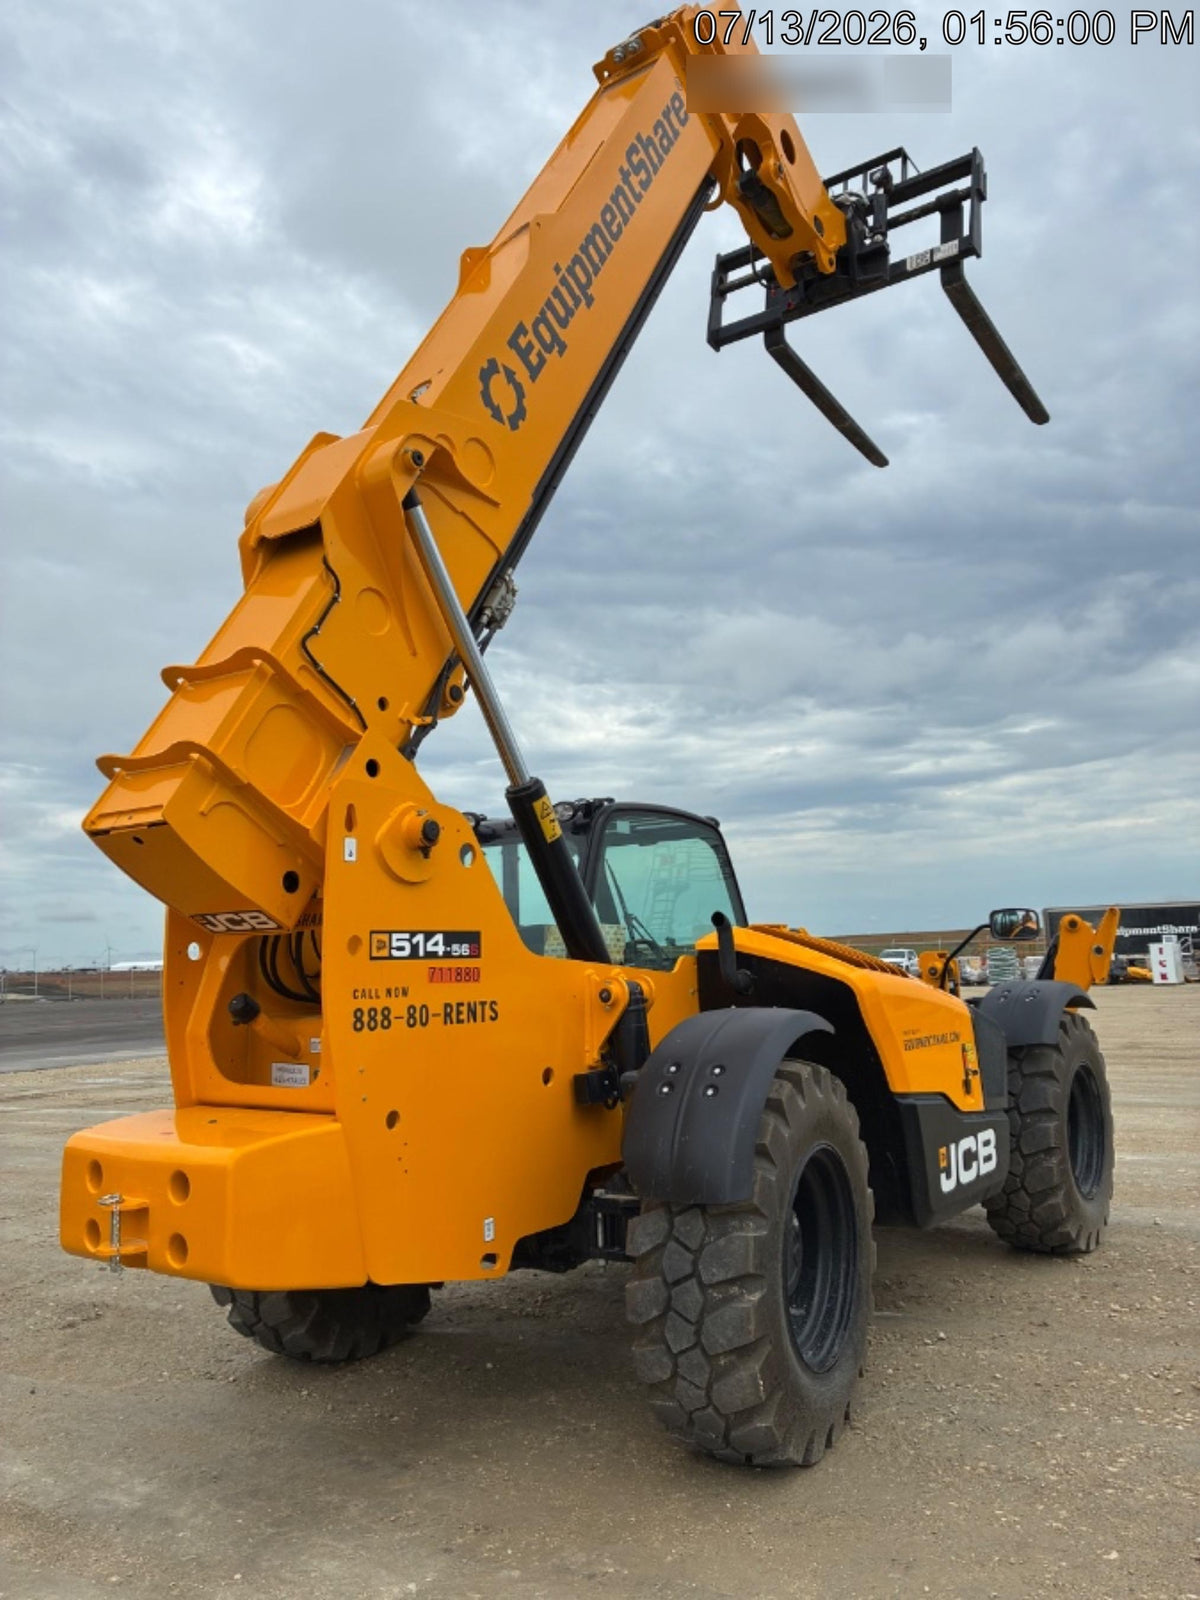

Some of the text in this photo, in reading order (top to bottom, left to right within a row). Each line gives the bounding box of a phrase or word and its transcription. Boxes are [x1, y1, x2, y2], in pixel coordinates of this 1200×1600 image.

[507, 91, 689, 384] EquipmentShare
[204, 911, 279, 932] JCB
[428, 967, 480, 983] 711880
[353, 986, 409, 999] CALL NOW
[353, 1000, 499, 1032] 888-80-RENTS
[940, 1128, 997, 1194] JCB
